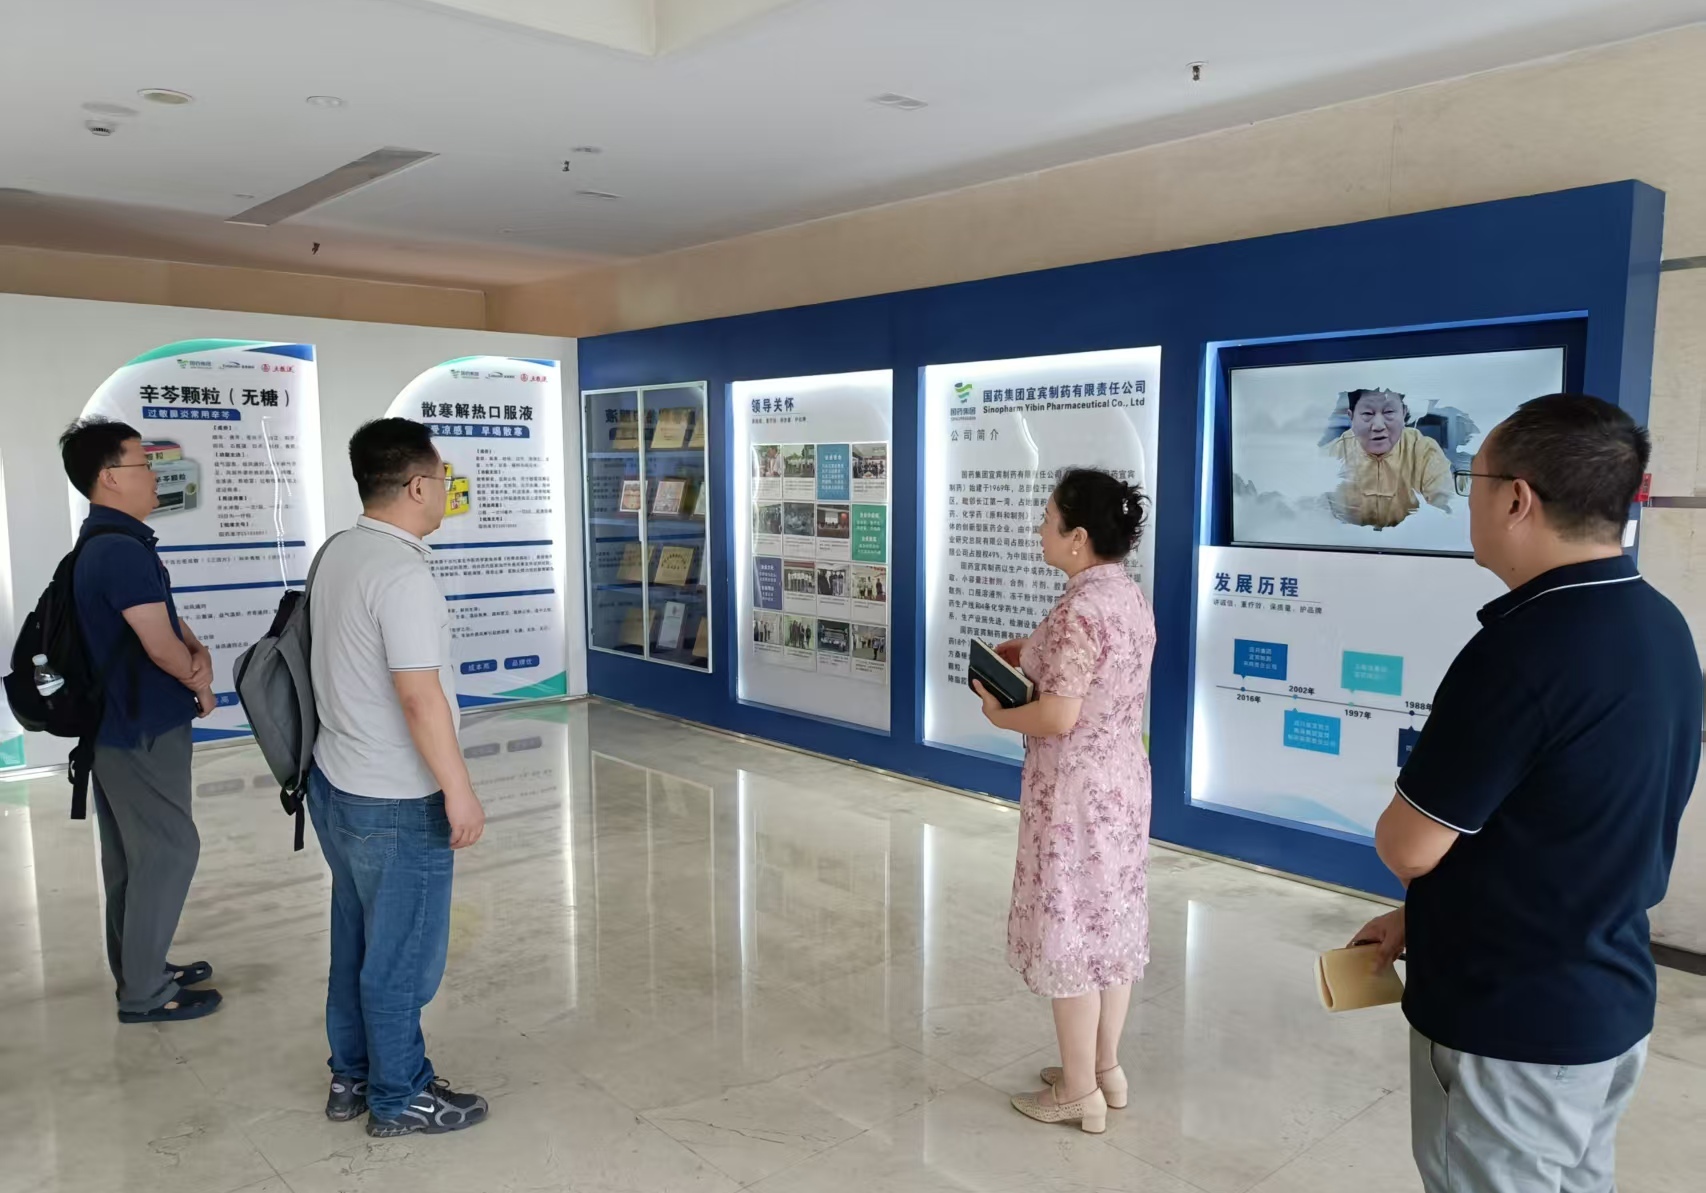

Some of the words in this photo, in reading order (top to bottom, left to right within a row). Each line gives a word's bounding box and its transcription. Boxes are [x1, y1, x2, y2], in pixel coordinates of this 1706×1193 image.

[140, 385, 290, 407] 辛芩颗粒（无糖）
[983, 380, 1146, 403] 国药集团宜宾制药有限责任公司
[751, 397, 794, 413] 领导关怀
[983, 405, 1023, 414] Sinopharm
[1025, 403, 1045, 411] Yibin
[1046, 399, 1110, 411] Pharmaceutical
[1130, 397, 1145, 406] Ltd
[147, 409, 231, 420] 过敏鼻炎常用辛芩
[421, 402, 533, 421] 散寒解热口服液
[431, 425, 474, 436] 受凉感冒
[481, 426, 523, 437] 早喝散寒
[950, 428, 999, 441] 公司简介
[949, 536, 1041, 547] 业研究总院有限公司占股权51
[1214, 572, 1299, 597] 发展历程
[1288, 685, 1315, 696] 2002年
[1236, 693, 1262, 703] 2016年
[1405, 700, 1433, 712] 1988年
[1344, 708, 1372, 720] 1997年
